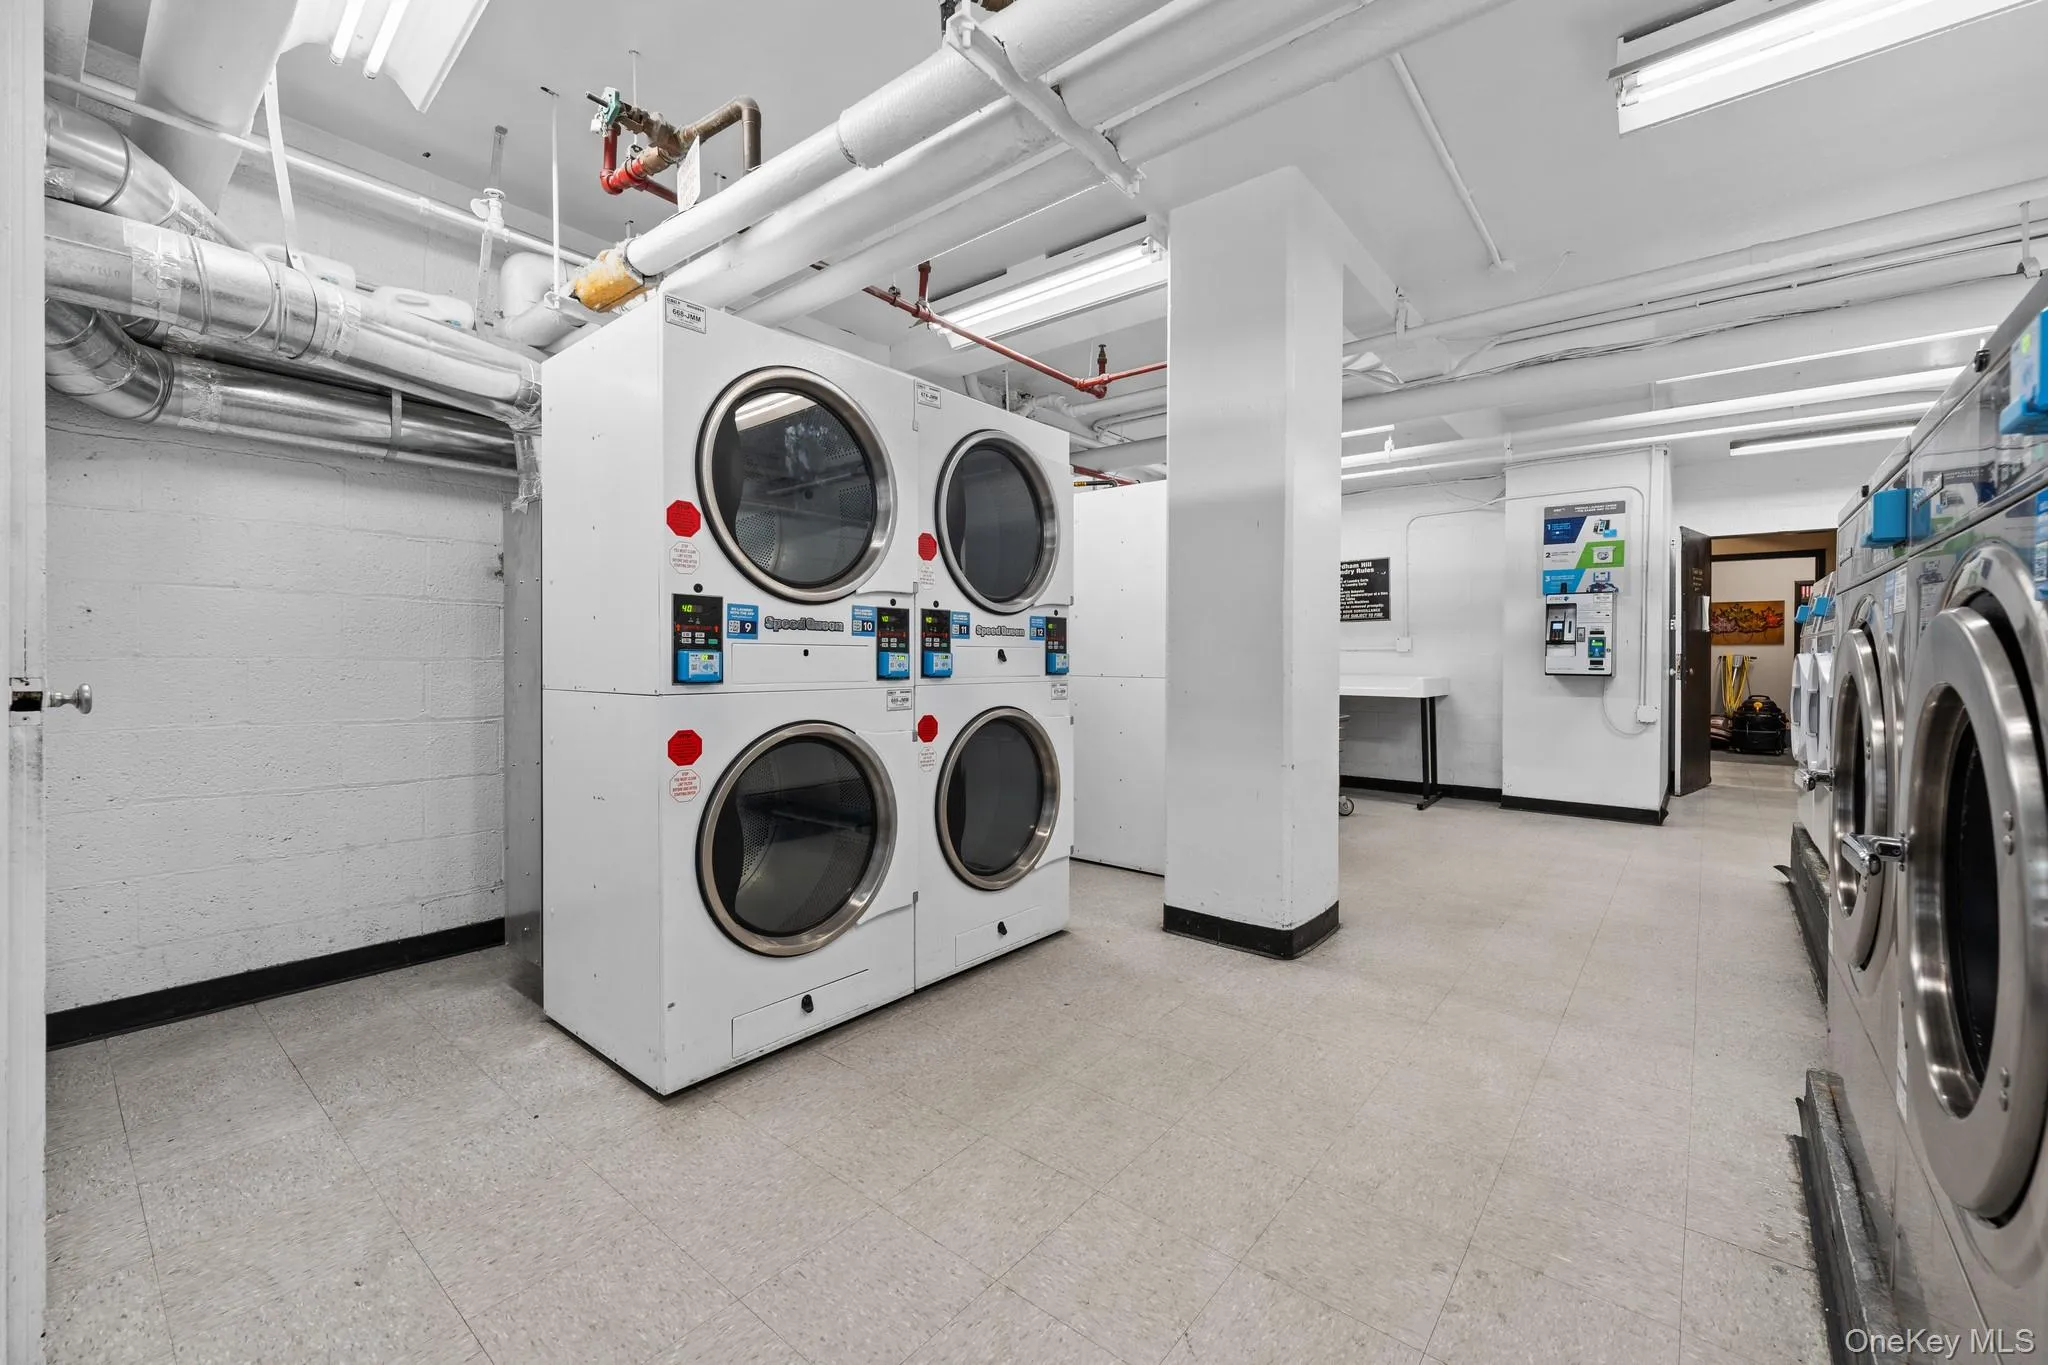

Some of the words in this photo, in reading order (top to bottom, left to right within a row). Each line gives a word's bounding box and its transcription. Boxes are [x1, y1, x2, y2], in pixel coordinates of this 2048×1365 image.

[681, 604, 692, 613] 40
[745, 622, 752, 633] 9
[764, 615, 806, 632] Speed
[806, 617, 844, 632] Queen
[863, 621, 873, 631] 10
[961, 626, 967, 634] 11
[975, 625, 1001, 637] Speed
[1001, 626, 1025, 637] Queen
[1037, 628, 1043, 636] 12
